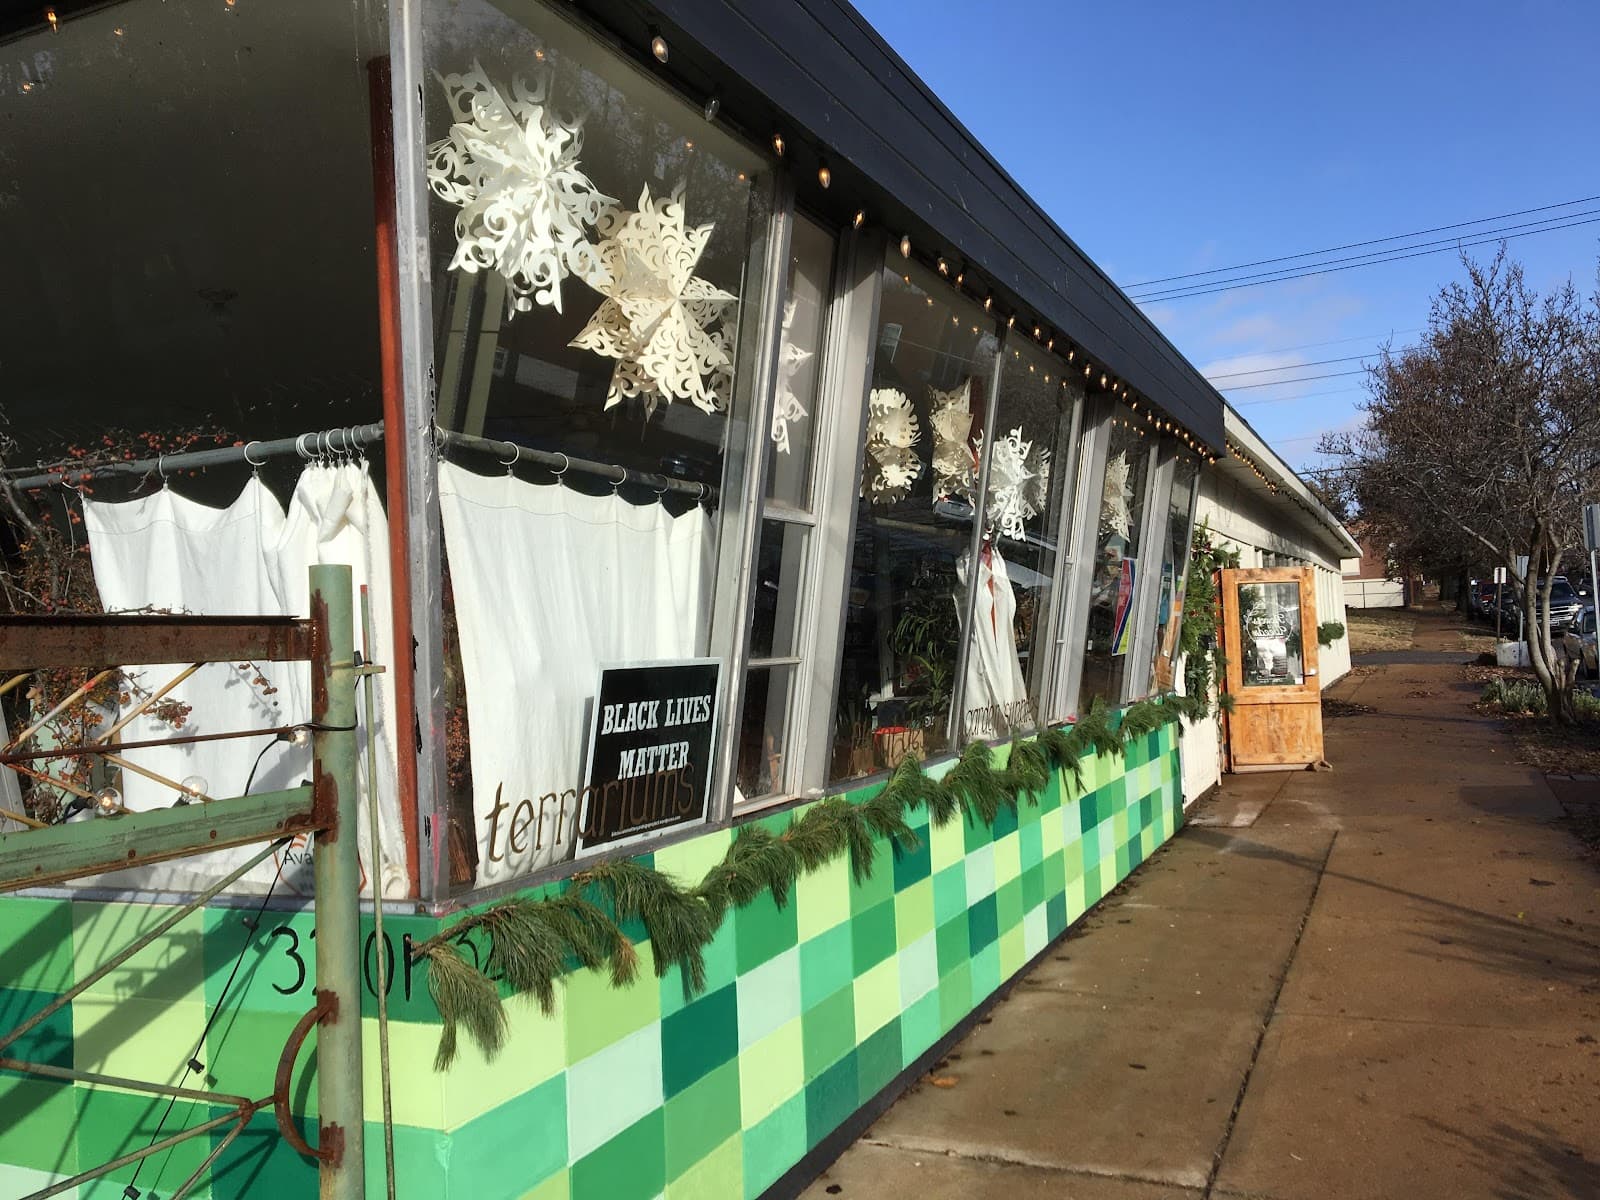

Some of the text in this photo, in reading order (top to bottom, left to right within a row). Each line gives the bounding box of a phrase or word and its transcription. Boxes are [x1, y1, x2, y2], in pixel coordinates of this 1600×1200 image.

[601, 694, 711, 735] BLACK LIVES
[617, 741, 690, 780] MATTER
[484, 763, 695, 862] terrariums
[271, 926, 412, 1002] 301
